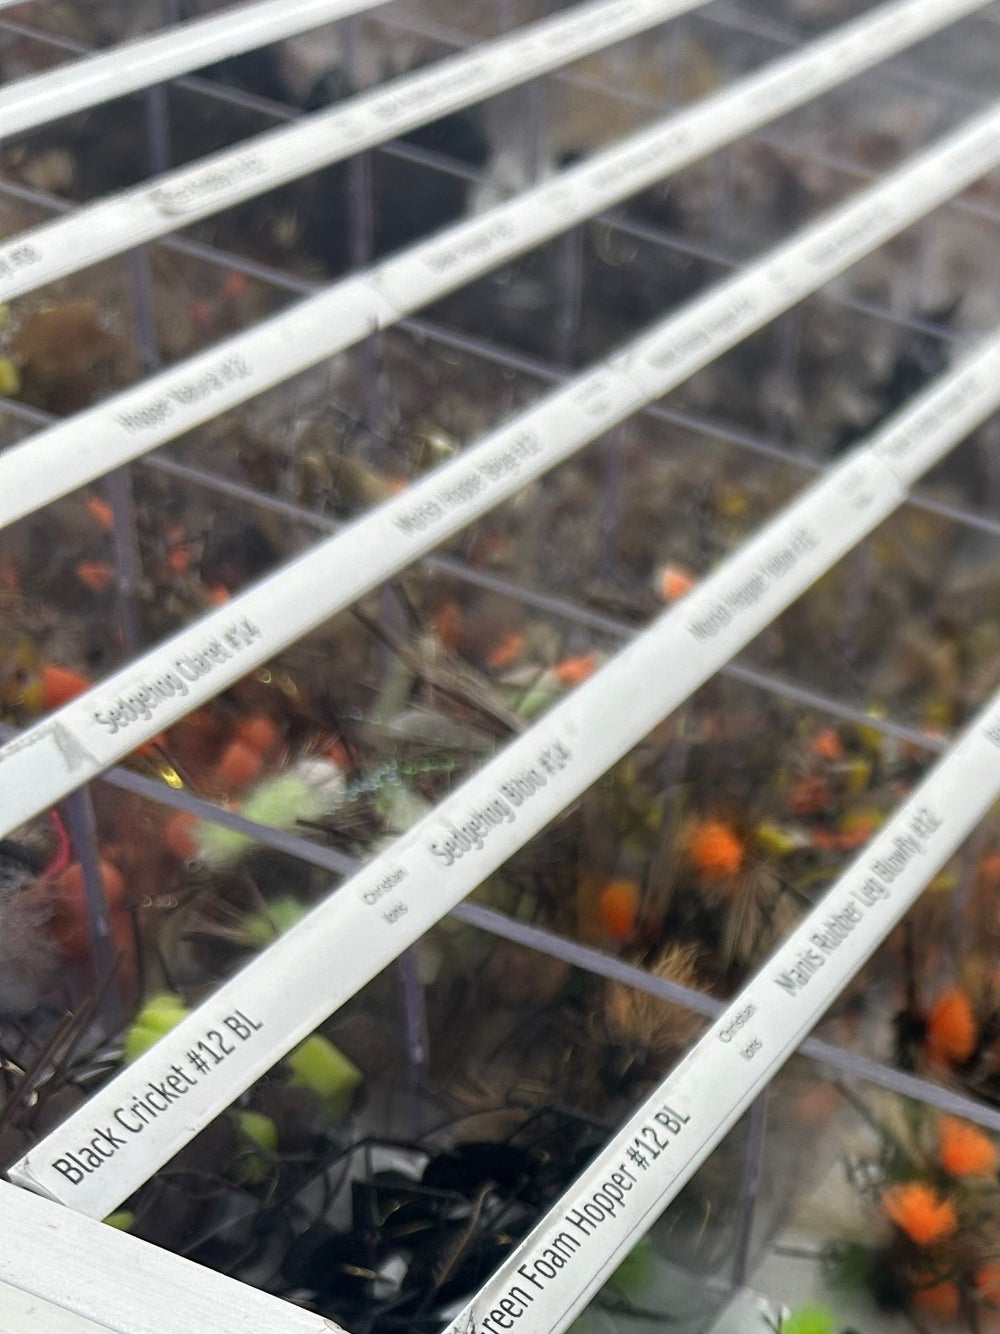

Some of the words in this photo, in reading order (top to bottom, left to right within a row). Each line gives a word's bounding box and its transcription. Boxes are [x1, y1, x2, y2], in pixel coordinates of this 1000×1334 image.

[50, 1127, 127, 1186] Black
[112, 1064, 198, 1134] Cricket
[185, 1029, 236, 1075] #12
[221, 1009, 264, 1042] BL
[516, 1231, 582, 1290] Foam
[564, 1163, 637, 1237] Hopper
[625, 1125, 670, 1171] #12
[653, 1104, 691, 1136] BL
